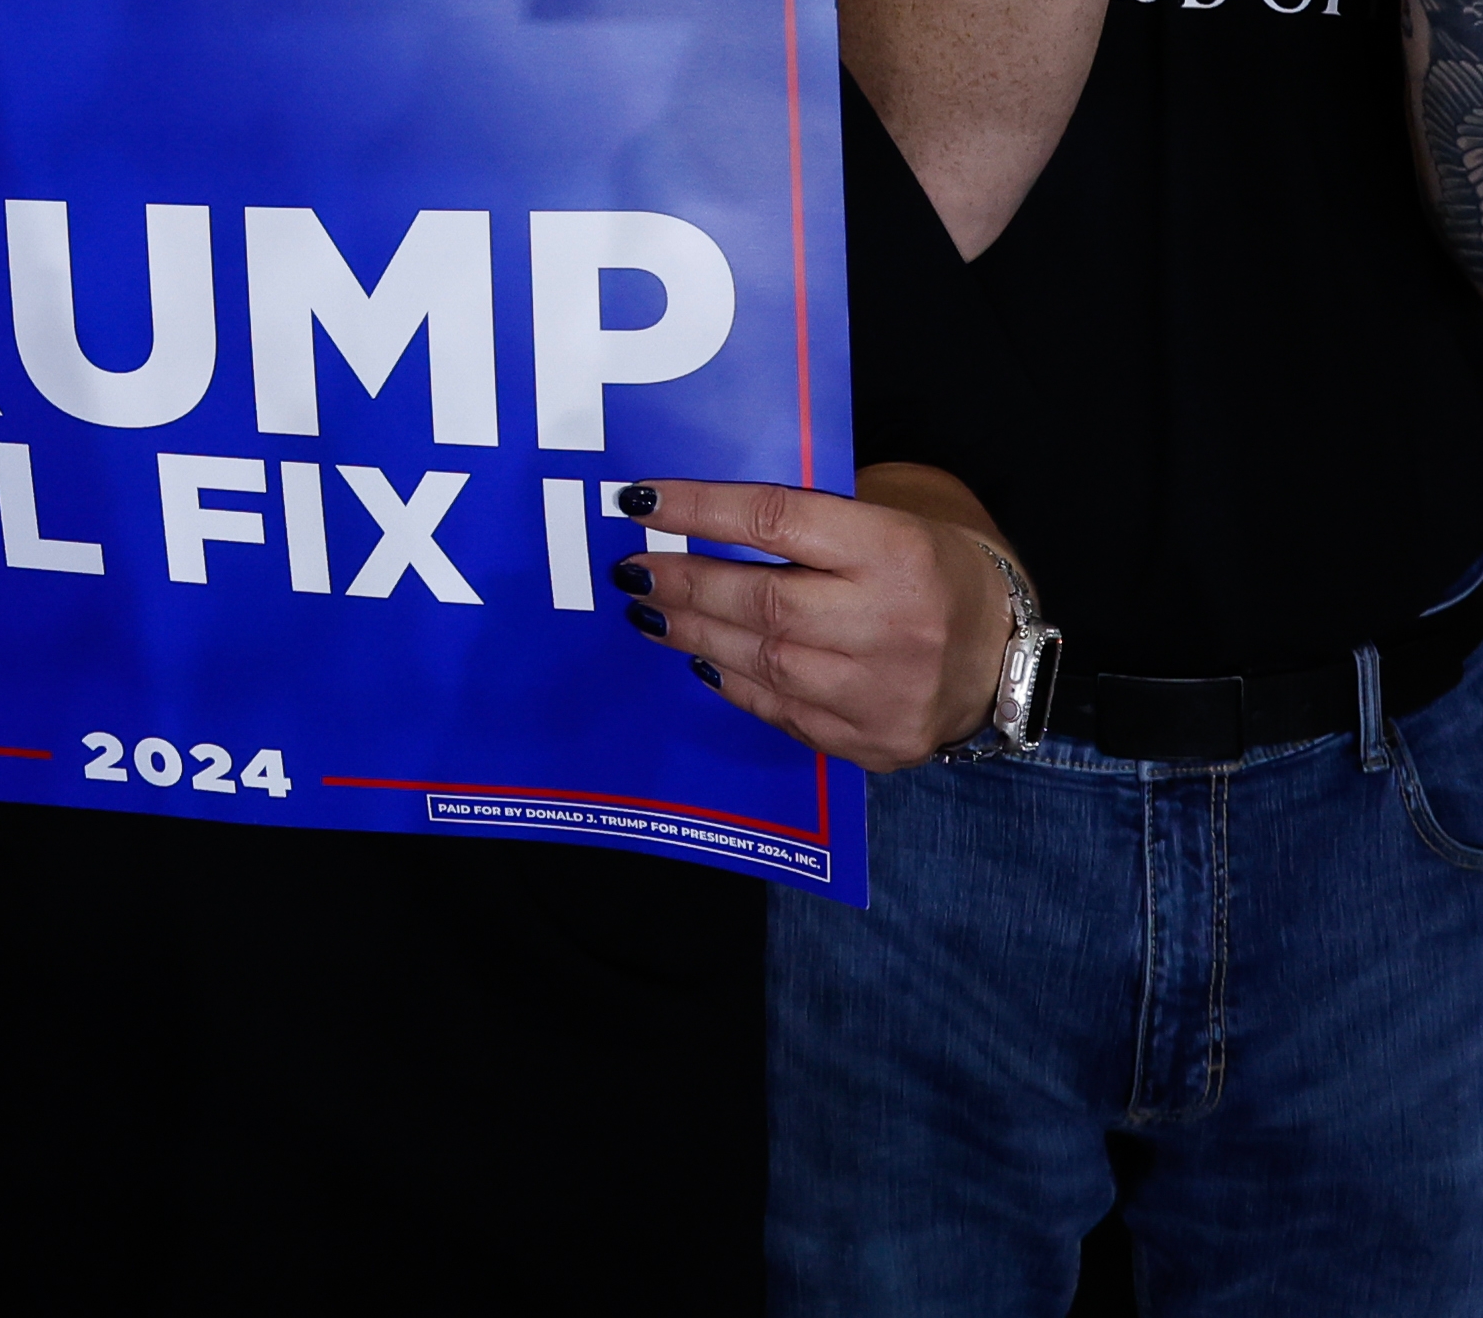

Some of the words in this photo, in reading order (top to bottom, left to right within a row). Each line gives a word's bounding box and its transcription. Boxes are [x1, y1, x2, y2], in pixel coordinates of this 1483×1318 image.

[156, 450, 486, 607] FIX
[80, 730, 293, 798] 2024
[437, 802, 471, 816] PAID
[473, 804, 502, 817] FOR
[504, 806, 524, 818] BY
[525, 808, 585, 824] DONALD
[586, 813, 599, 825] J.
[600, 815, 648, 832] TRUMP
[650, 821, 680, 838] FOR
[681, 826, 755, 853] PRESIDENT
[756, 842, 794, 864] 2024,
[793, 851, 822, 870] INC.
